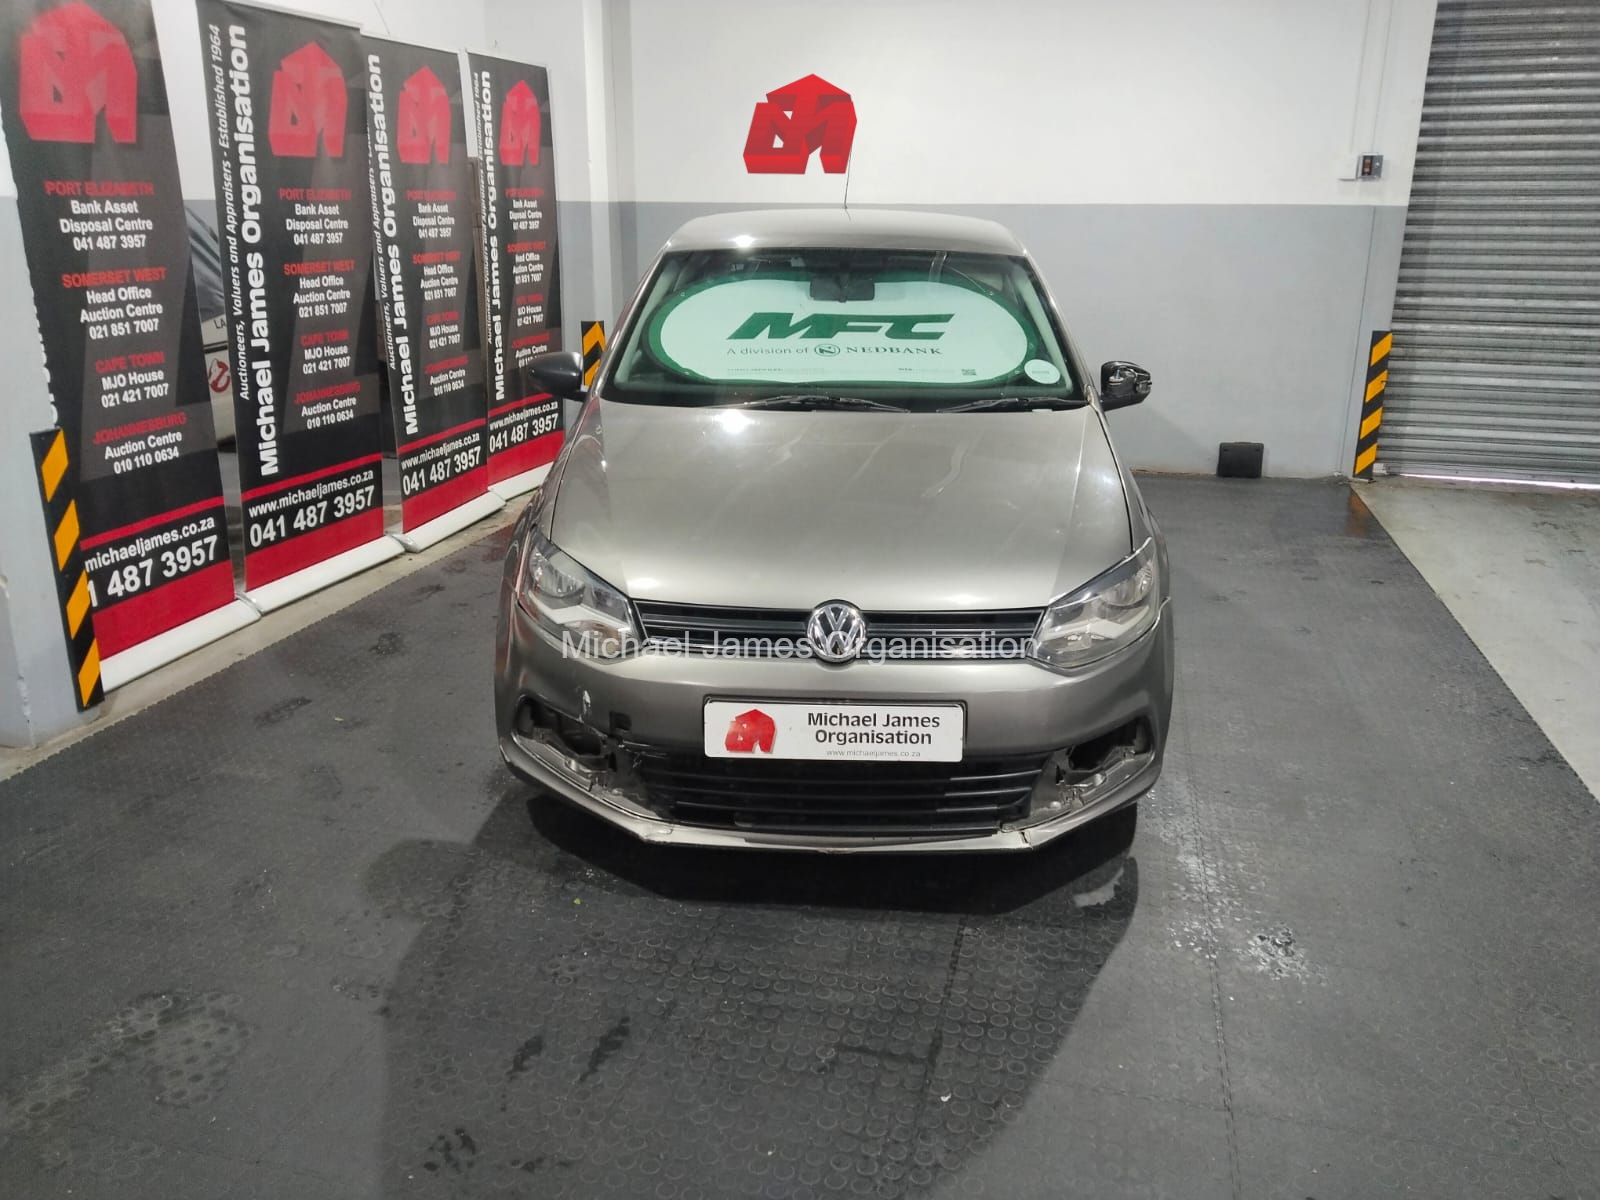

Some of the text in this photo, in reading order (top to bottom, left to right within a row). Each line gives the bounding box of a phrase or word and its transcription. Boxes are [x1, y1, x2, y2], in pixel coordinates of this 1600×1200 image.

[44, 181, 81, 195] PORT
[71, 200, 139, 214] Bank Asset
[208, 24, 250, 400] Auctioneers, Valuers and Appraisers Established 1964
[295, 203, 339, 215] Bank Asset
[59, 217, 153, 235] Disposal Centre
[285, 218, 349, 232] Disposal Centre
[73, 234, 146, 251] 041 487 3957
[293, 232, 343, 245] 041 487 3957
[368, 54, 418, 435] Michael James Organisation
[374, 230, 383, 254] and
[481, 71, 505, 401] Michael James Organisation
[228, 25, 279, 477] Michael James Organisation
[61, 267, 166, 288] SOMERSET WEST
[299, 275, 344, 289] Head Office
[86, 287, 151, 304] Head Office
[293, 289, 351, 304] Auction Centre
[80, 303, 163, 323] Auction Centre
[299, 306, 313, 318] 021
[330, 302, 347, 314] 7007
[89, 318, 159, 340] 021 851 7007
[726, 312, 955, 340] MFC
[304, 345, 348, 360] MJO House
[727, 347, 736, 356] A
[740, 346, 791, 355] division
[796, 346, 808, 355] of
[847, 346, 943, 355] NEDBANK
[95, 359, 127, 373] CAPE
[303, 356, 351, 375] 021 421 7007
[101, 369, 164, 391] MJO House
[101, 383, 169, 408] 021 421 7007
[302, 397, 357, 417] Auction Centre
[307, 409, 354, 430] 010 110 0634
[489, 413, 559, 453] 041 487 3957
[104, 430, 182, 460] Auction Centre
[401, 433, 480, 470] www.michaeljames.co.za
[114, 448, 180, 474] 010 110 0634
[403, 446, 481, 496] 041 487 3957
[249, 469, 374, 518] www.michaeljames.co.za
[250, 485, 375, 548] 041 487 3957
[84, 515, 215, 572] michaeljames.co.za
[106, 559, 155, 599] 487
[159, 535, 219, 578] 3957
[807, 712, 940, 728] Michael James
[815, 729, 932, 745] Organisation
[826, 749, 921, 758] www.michaeljames.co.za
